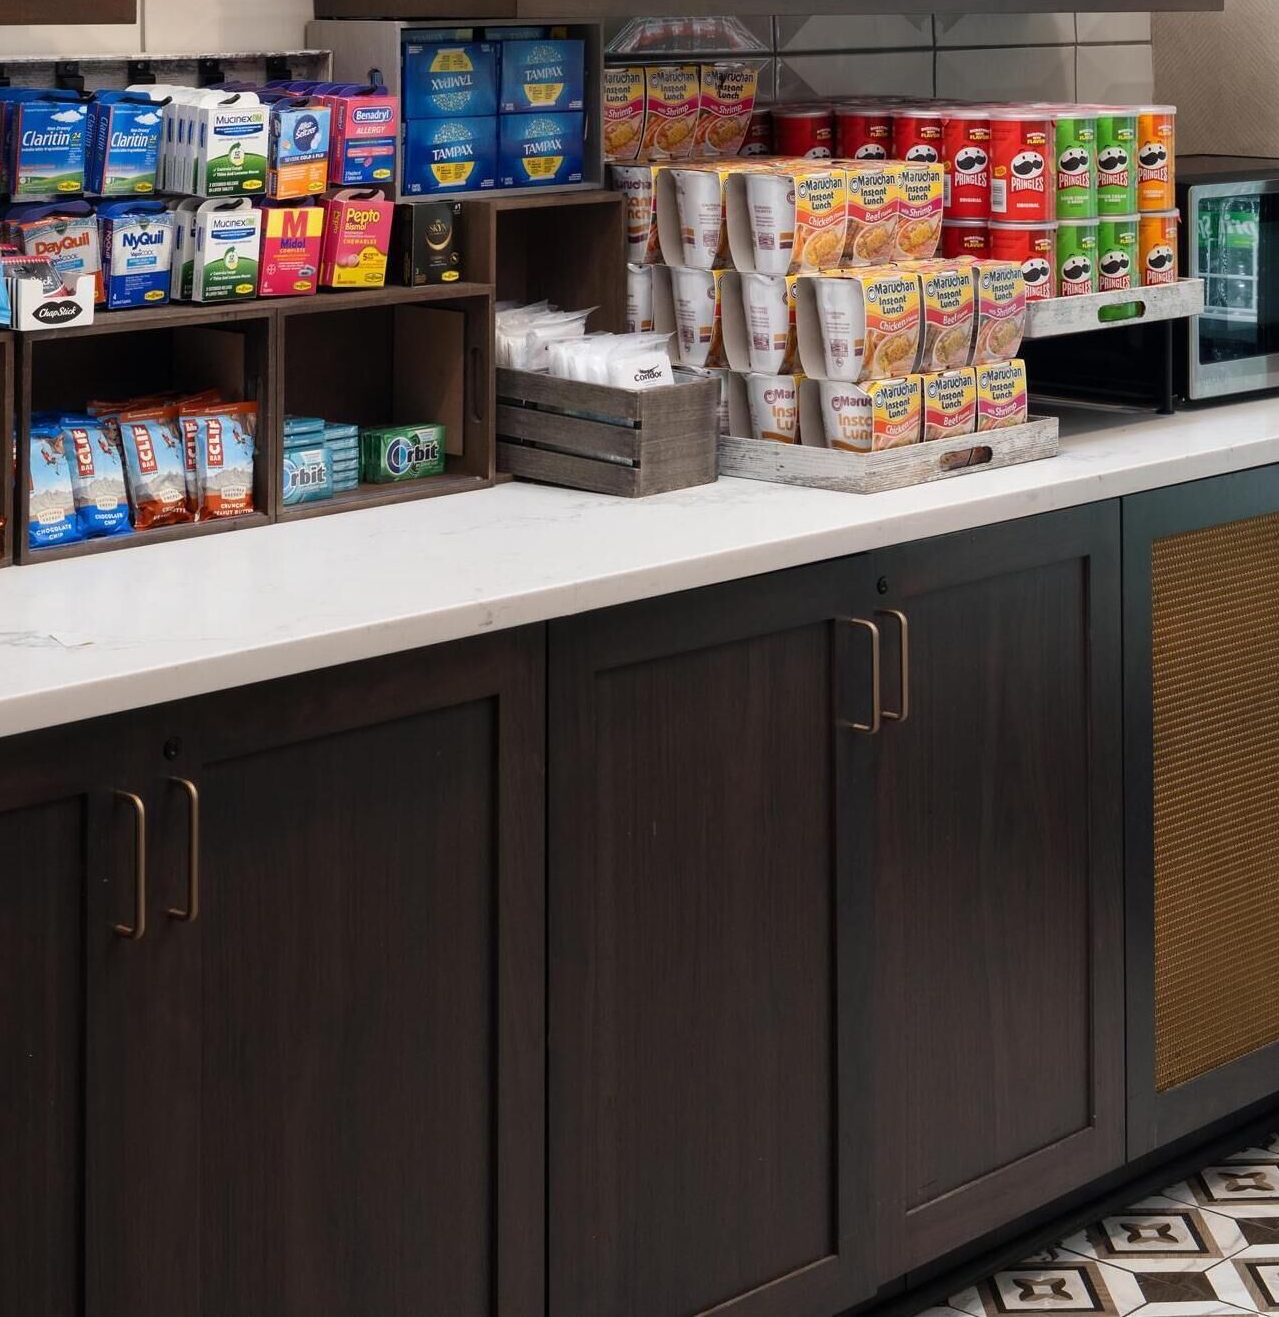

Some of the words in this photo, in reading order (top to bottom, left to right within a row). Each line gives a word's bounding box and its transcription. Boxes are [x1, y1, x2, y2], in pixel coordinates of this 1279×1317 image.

[525, 65, 564, 82] TAMPAX
[431, 73, 474, 91] TAMPAX
[355, 109, 390, 123] Benadryl
[608, 105, 633, 118] Shrimp
[666, 104, 689, 116] Shrimp
[296, 126, 317, 140] Seltzer
[355, 126, 386, 134] ALLERGY
[22, 130, 70, 148] Claritin
[111, 132, 149, 148] Claritin
[432, 143, 474, 161] TAMPAX
[523, 138, 562, 156] TAMPAX
[857, 173, 895, 187] Maruchan
[902, 172, 940, 183] Maruchan
[954, 171, 987, 187] PRINGLES
[1058, 171, 1090, 188] PRINGLES
[1097, 170, 1128, 187] PRINGLES
[1138, 166, 1168, 183] PRINGLES
[806, 178, 843, 191] Maruchan
[905, 184, 931, 193] Instant
[1010, 176, 1044, 192] PRINGLES
[809, 192, 834, 202] Instant
[861, 187, 887, 197] Instant
[908, 192, 928, 201] Lunch
[812, 201, 831, 211] Lunch
[863, 196, 885, 206] Lunch
[282, 210, 309, 233] M
[346, 208, 380, 224] Pepto
[808, 215, 835, 225] Chicken
[865, 211, 881, 222] Beef
[345, 222, 366, 231] Bismol
[34, 233, 91, 257] DayQuil
[122, 232, 164, 251] NyQuil
[280, 237, 306, 249] Midol
[874, 280, 916, 295] Maruchan
[933, 274, 970, 288] Maruchan
[1062, 280, 1091, 296] PRINGLES
[879, 295, 907, 306] Instant
[936, 289, 962, 300] Instant
[882, 304, 904, 315] Lunch
[940, 299, 960, 309] Lunch
[38, 305, 78, 318] ChapStick
[879, 319, 907, 330] Chicken
[942, 313, 958, 325] Beef
[633, 371, 662, 382] Condor
[987, 367, 1022, 382] Maruchan
[935, 375, 973, 390] Maruchan
[995, 402, 1017, 417] Shrimp
[943, 415, 958, 426] Beef
[885, 423, 910, 435] Chicken
[134, 426, 154, 462] CLIF
[206, 418, 222, 456] CLIF
[73, 429, 92, 464] CLIF
[386, 437, 440, 475] Orbit
[36, 524, 71, 536] CHOCOLATE
[48, 532, 64, 540] CHIP
